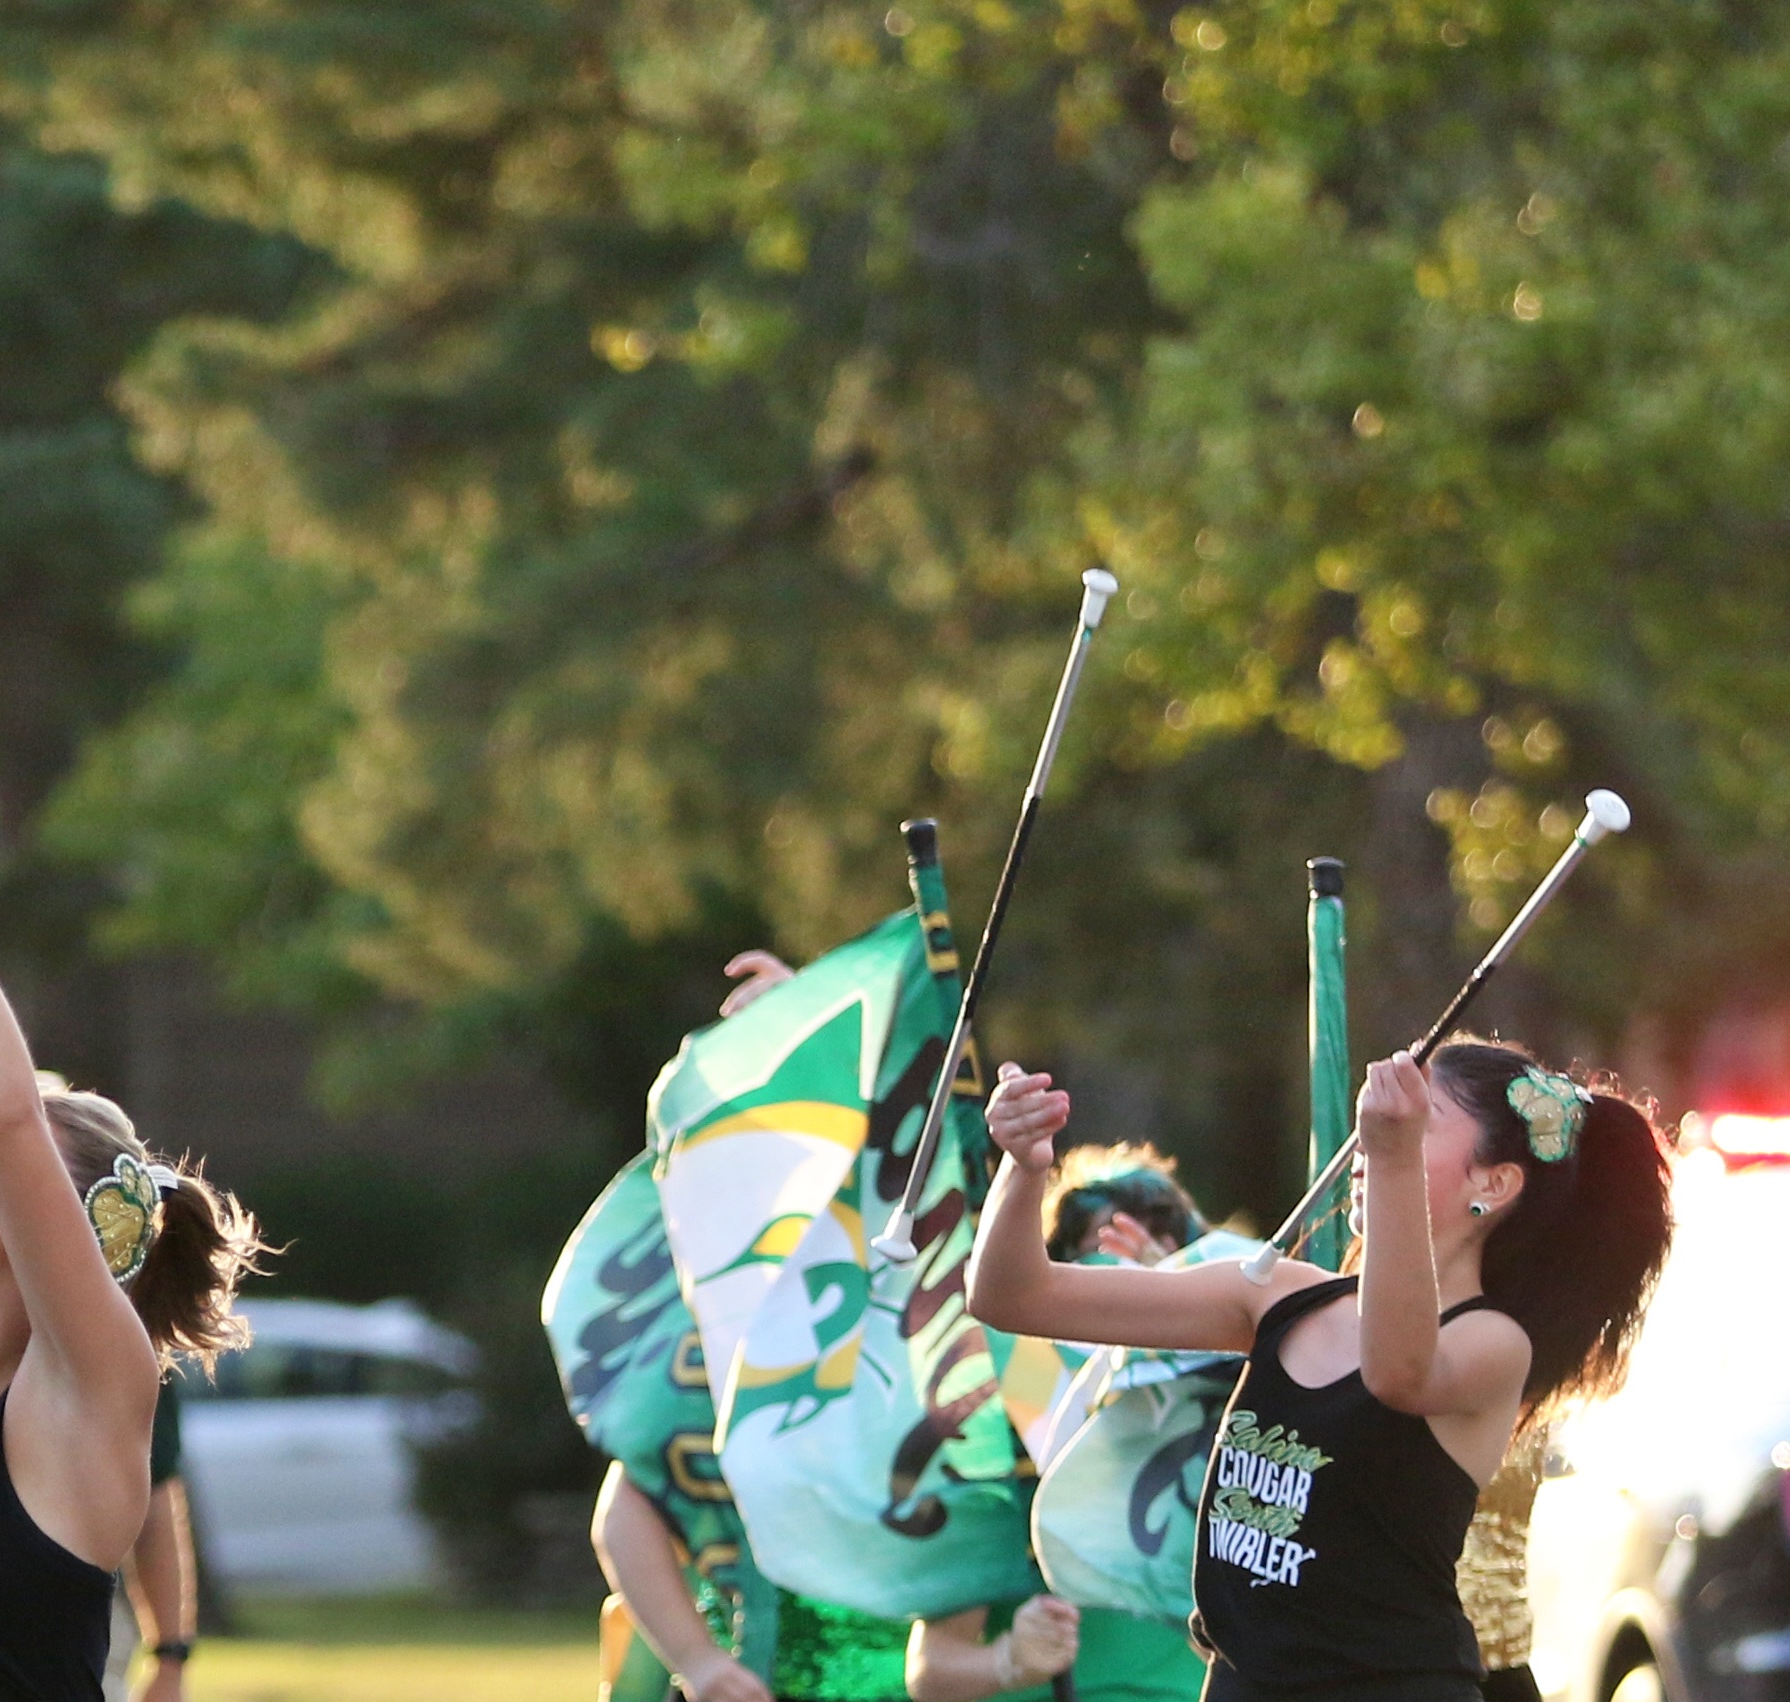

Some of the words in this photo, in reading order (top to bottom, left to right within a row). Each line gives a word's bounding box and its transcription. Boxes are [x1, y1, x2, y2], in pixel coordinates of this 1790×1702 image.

[1220, 1410, 1334, 1472] Salina
[1218, 1447, 1312, 1514] COUGAR
[1208, 1515, 1301, 1587] TWIRLER
